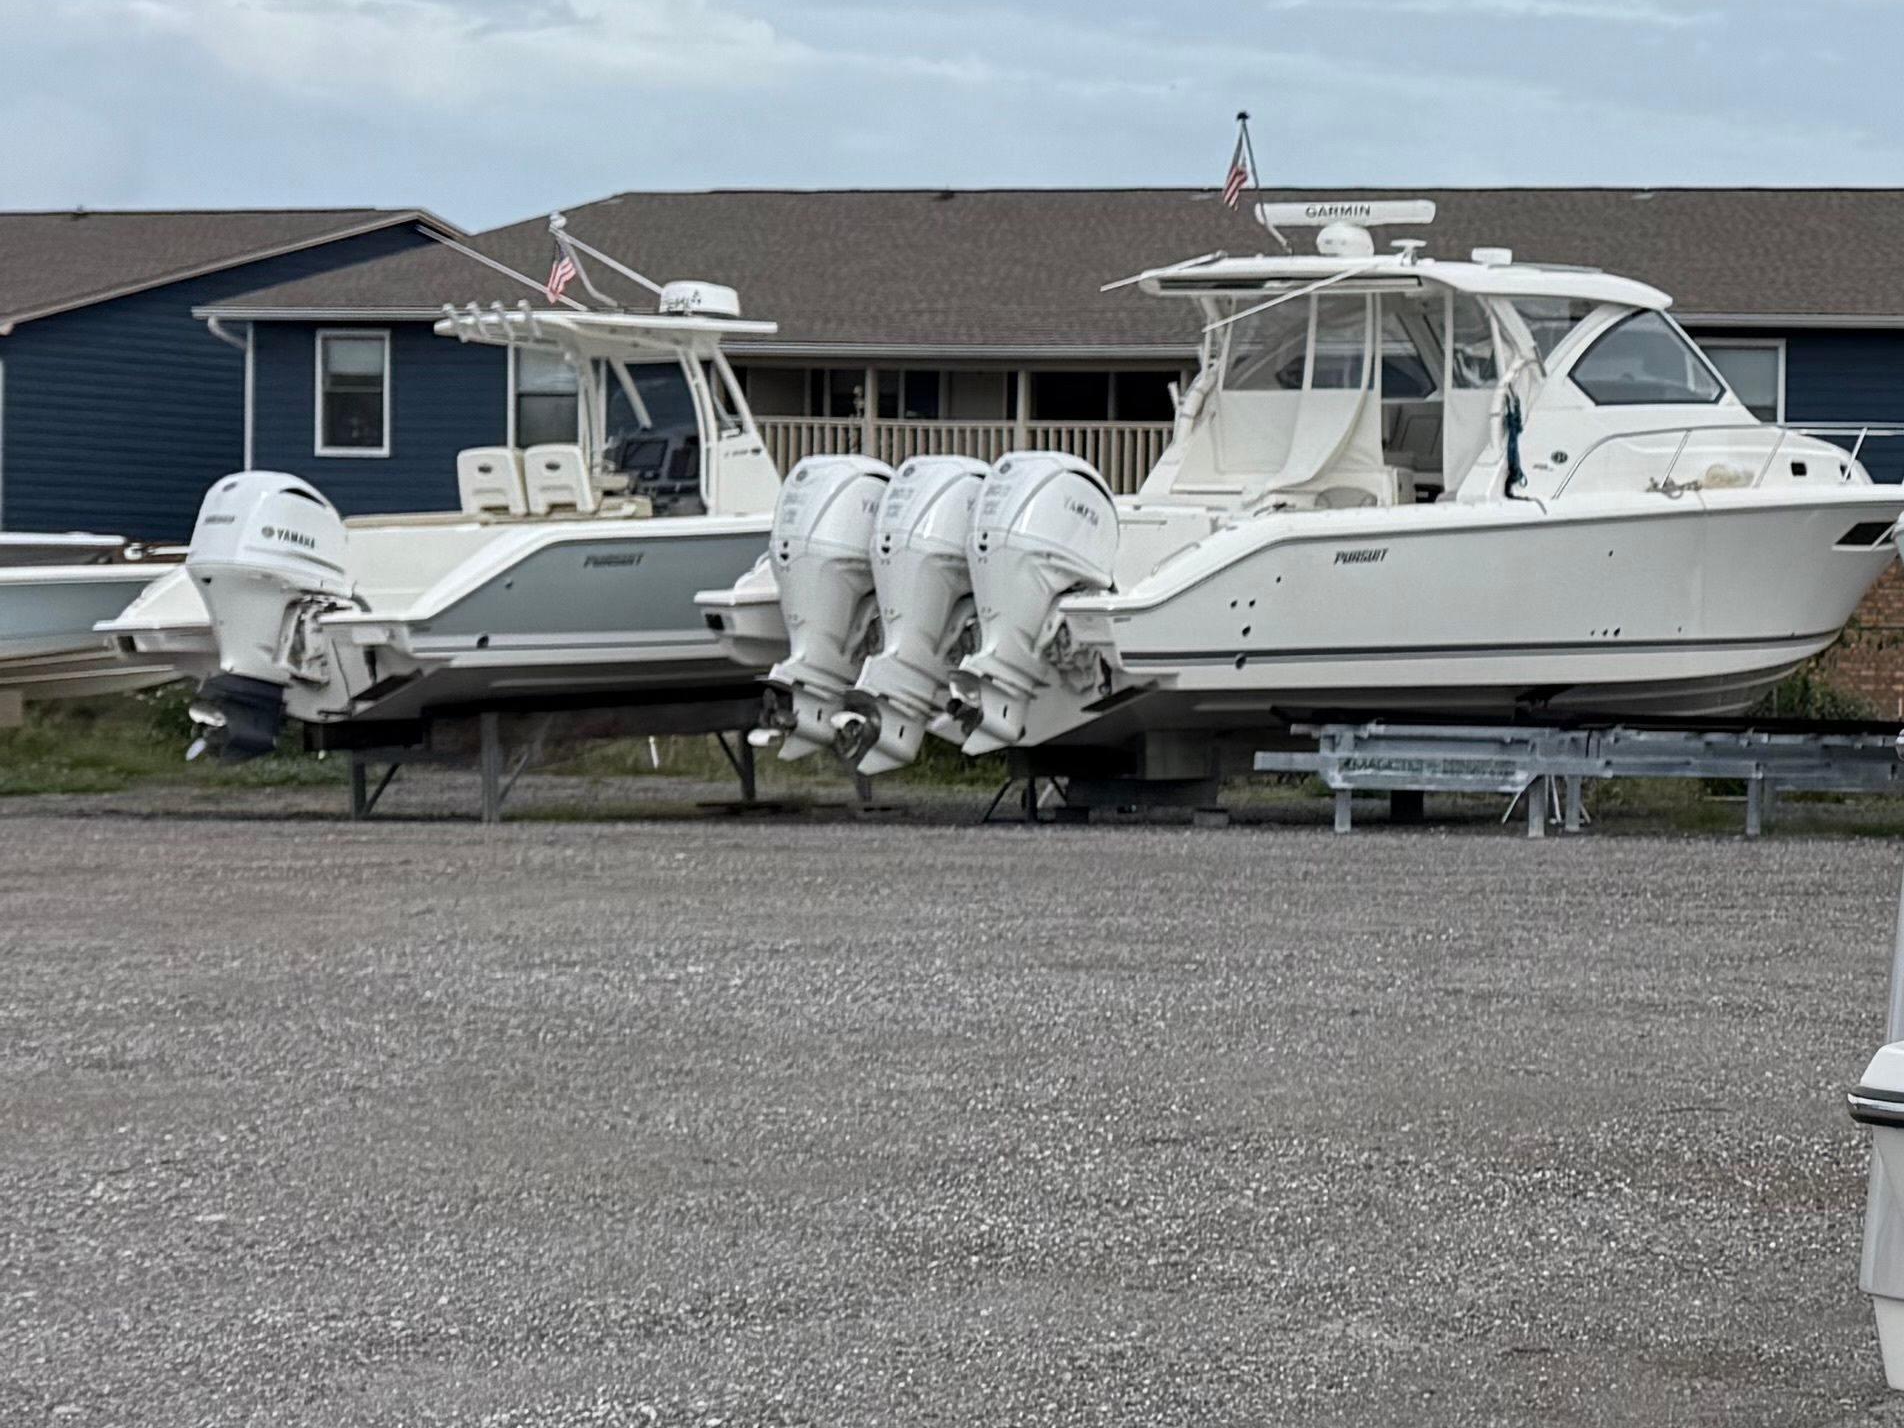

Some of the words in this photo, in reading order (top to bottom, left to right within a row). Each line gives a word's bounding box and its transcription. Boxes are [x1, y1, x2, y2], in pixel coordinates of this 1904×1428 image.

[1305, 204, 1371, 219] GARMIN
[277, 528, 316, 549] YAMAHA
[1334, 548, 1389, 564] PURSUIT
